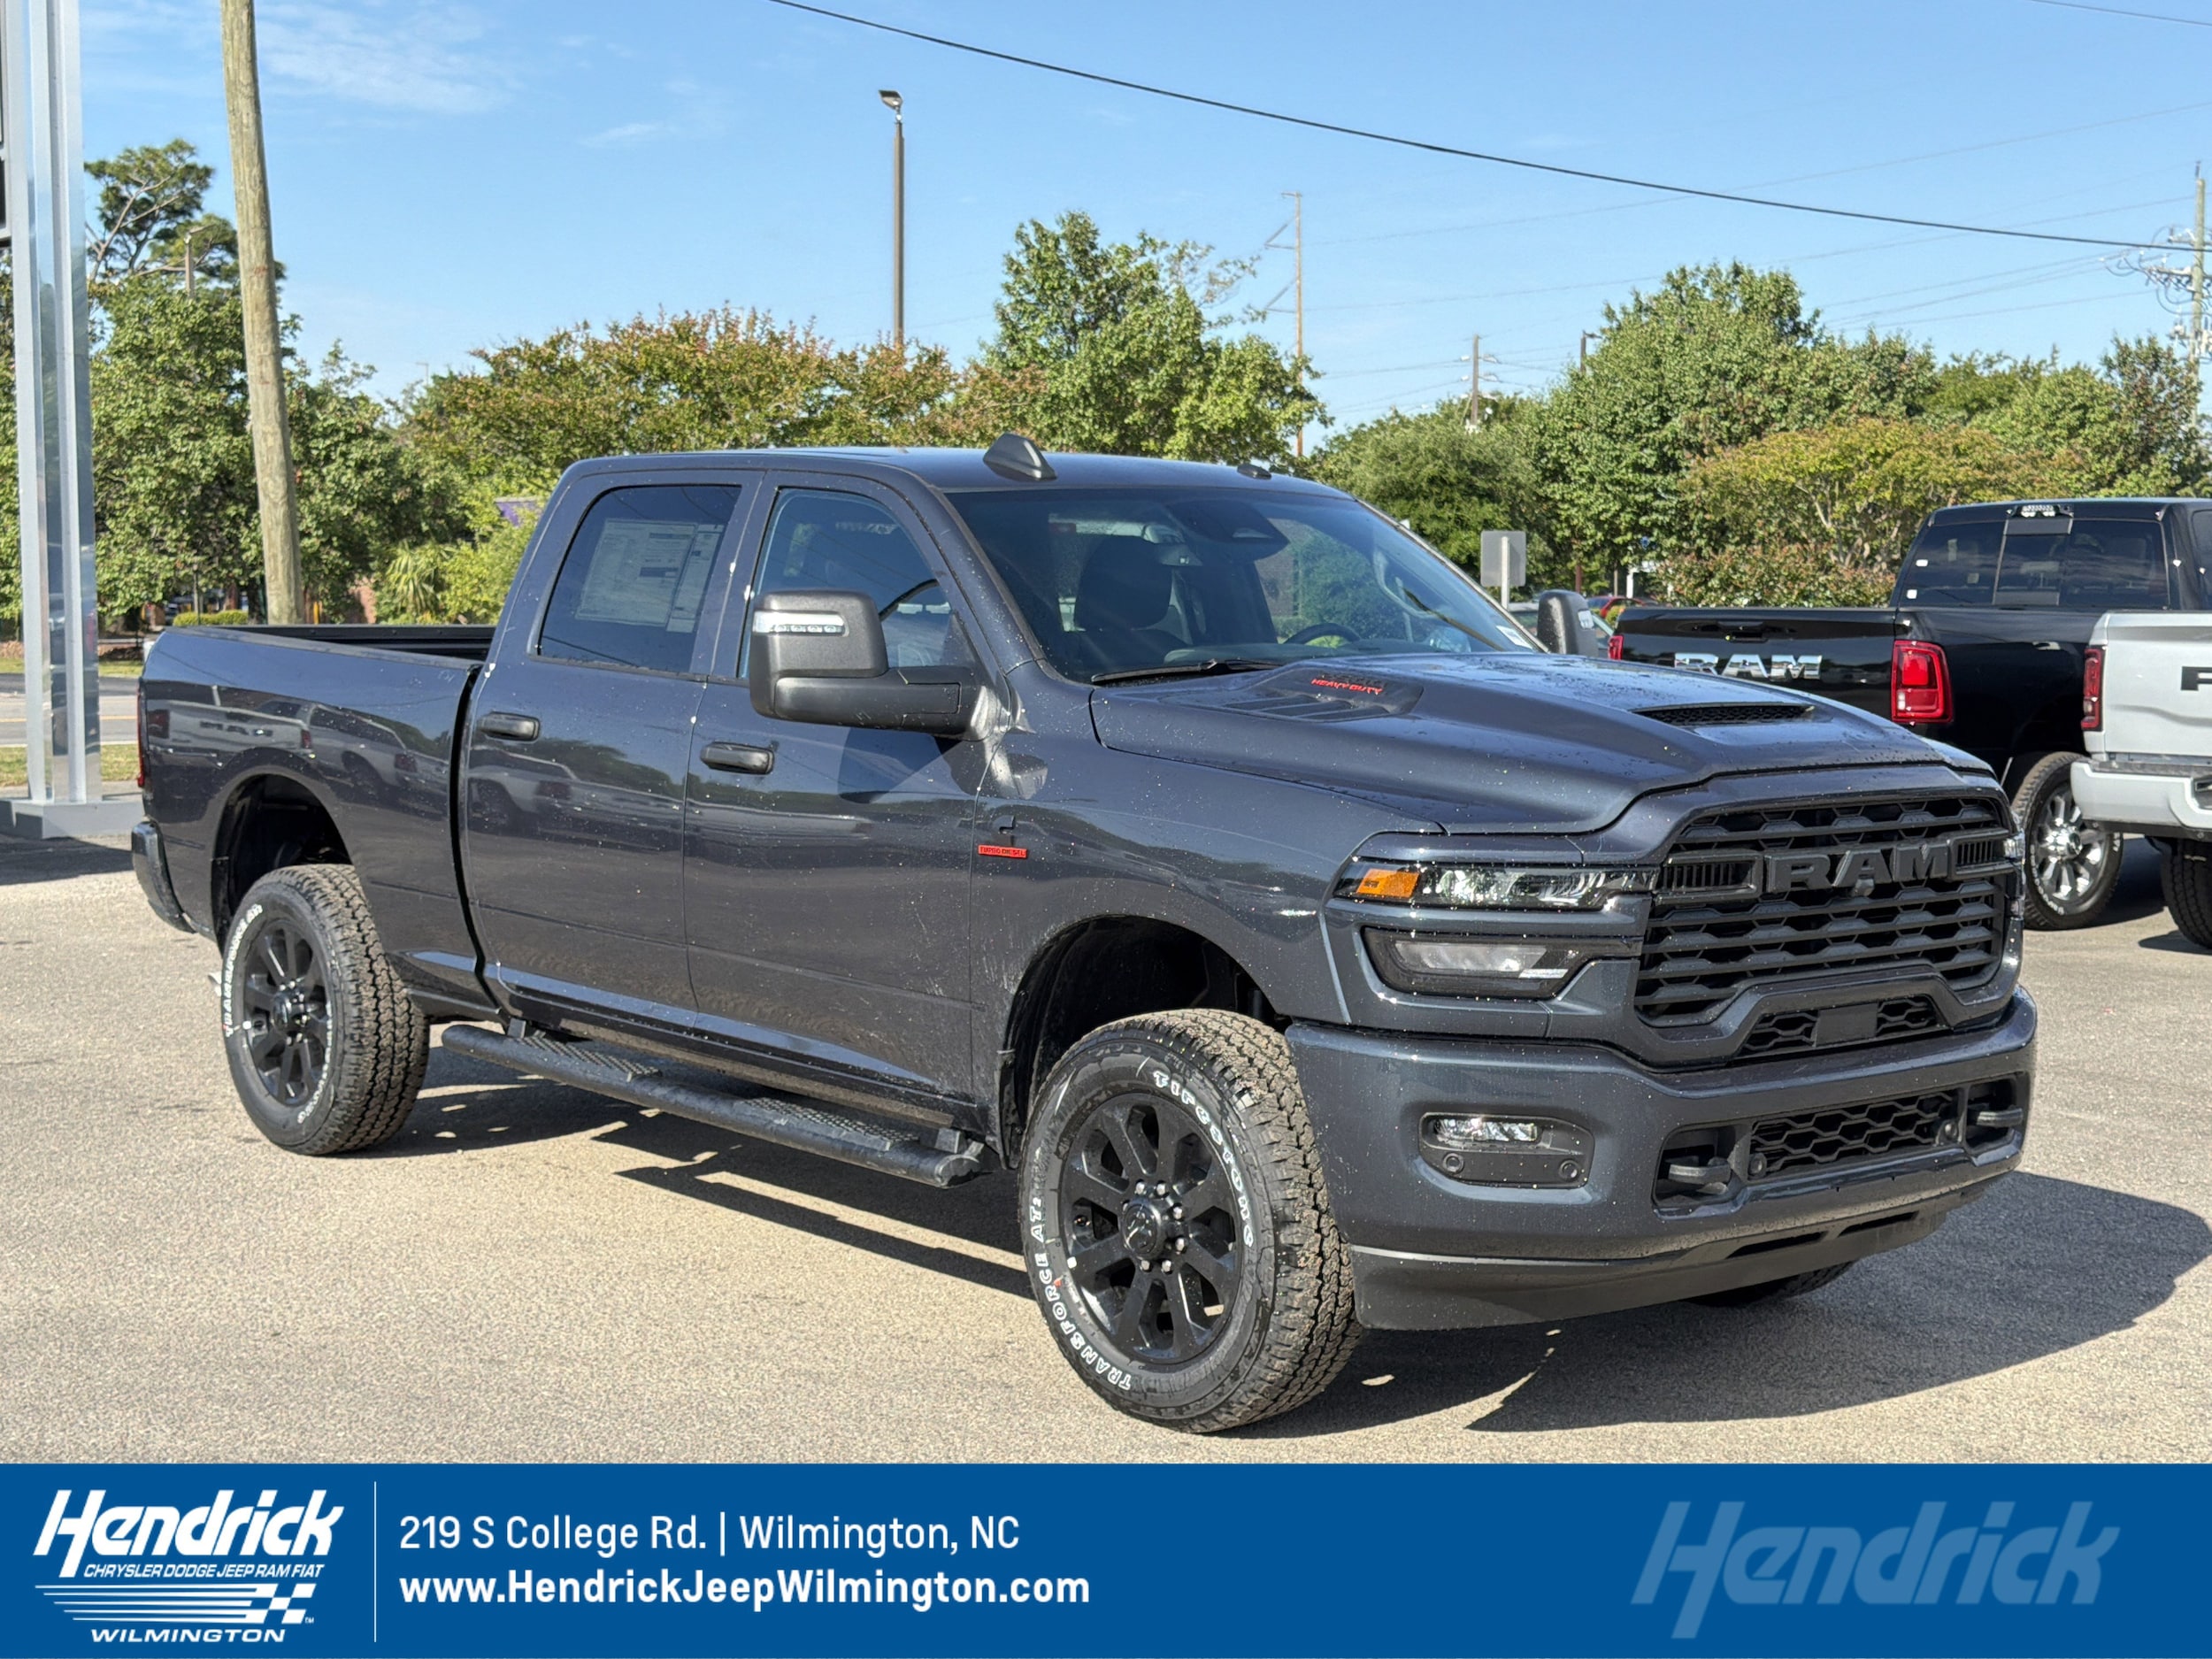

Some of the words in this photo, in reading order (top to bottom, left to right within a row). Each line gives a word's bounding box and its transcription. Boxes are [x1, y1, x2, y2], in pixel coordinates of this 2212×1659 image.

[1675, 653, 1823, 680] RAM
[1310, 679, 1349, 689] HEAVY
[1349, 684, 1383, 695] DUTY
[1763, 841, 1951, 895] RAM
[1034, 1252, 1133, 1391] TRANSFORCE
